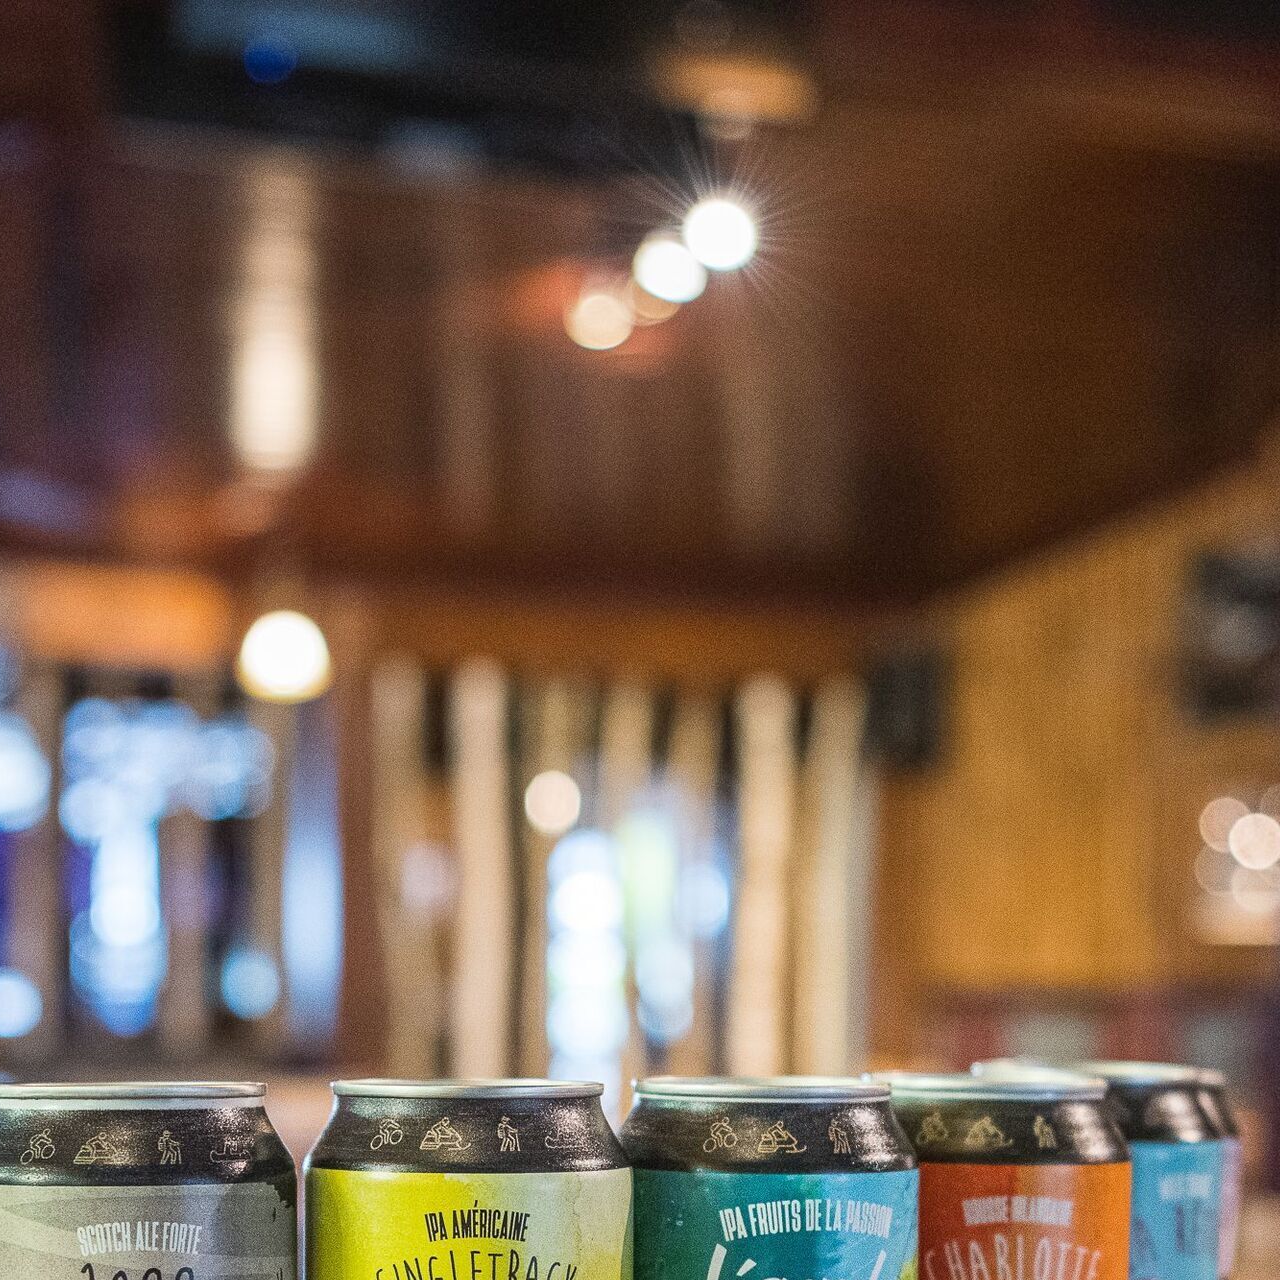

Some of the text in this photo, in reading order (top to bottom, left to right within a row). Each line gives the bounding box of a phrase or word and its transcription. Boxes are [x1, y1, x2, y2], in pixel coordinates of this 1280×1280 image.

[76, 1220, 203, 1257] SCOTCH ALE FORTE
[424, 1200, 531, 1243] IPA AMÉRICAINE
[720, 1206, 748, 1242] IPA
[748, 1199, 801, 1237] FRUITS
[805, 1198, 822, 1232] DE
[825, 1198, 842, 1232] LA
